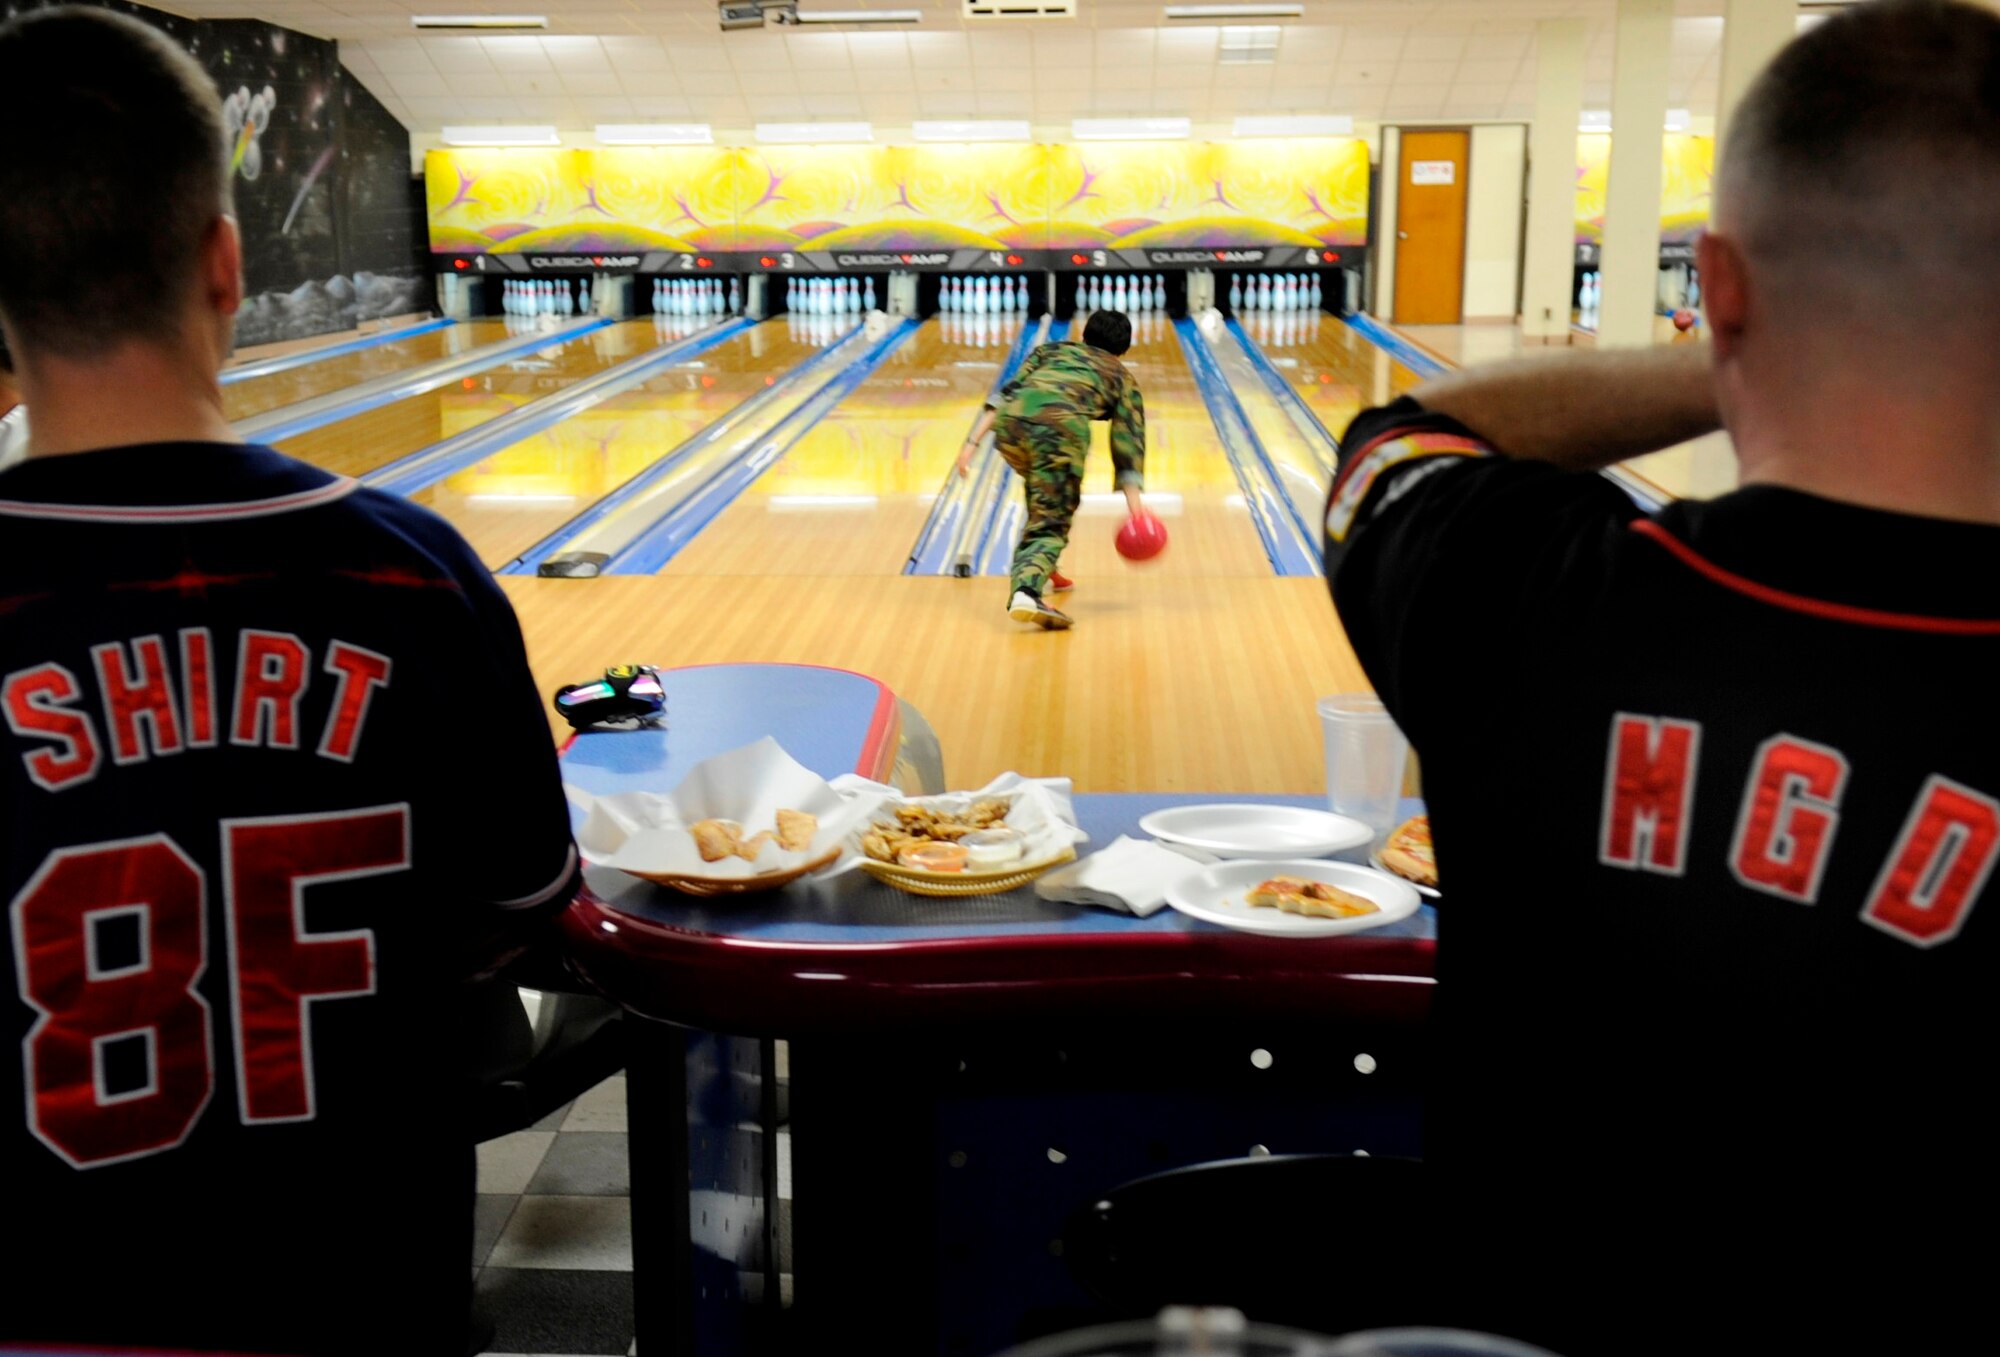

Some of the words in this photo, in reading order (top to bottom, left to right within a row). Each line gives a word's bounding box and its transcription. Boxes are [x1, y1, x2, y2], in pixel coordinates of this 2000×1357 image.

[475, 255, 485, 270] 1
[680, 254, 693, 270] 2
[782, 253, 794, 268] 3
[990, 252, 1002, 267] 4
[1306, 249, 1319, 264] 6
[1, 627, 392, 792] SHIRT
[10, 802, 412, 1170] 8F
